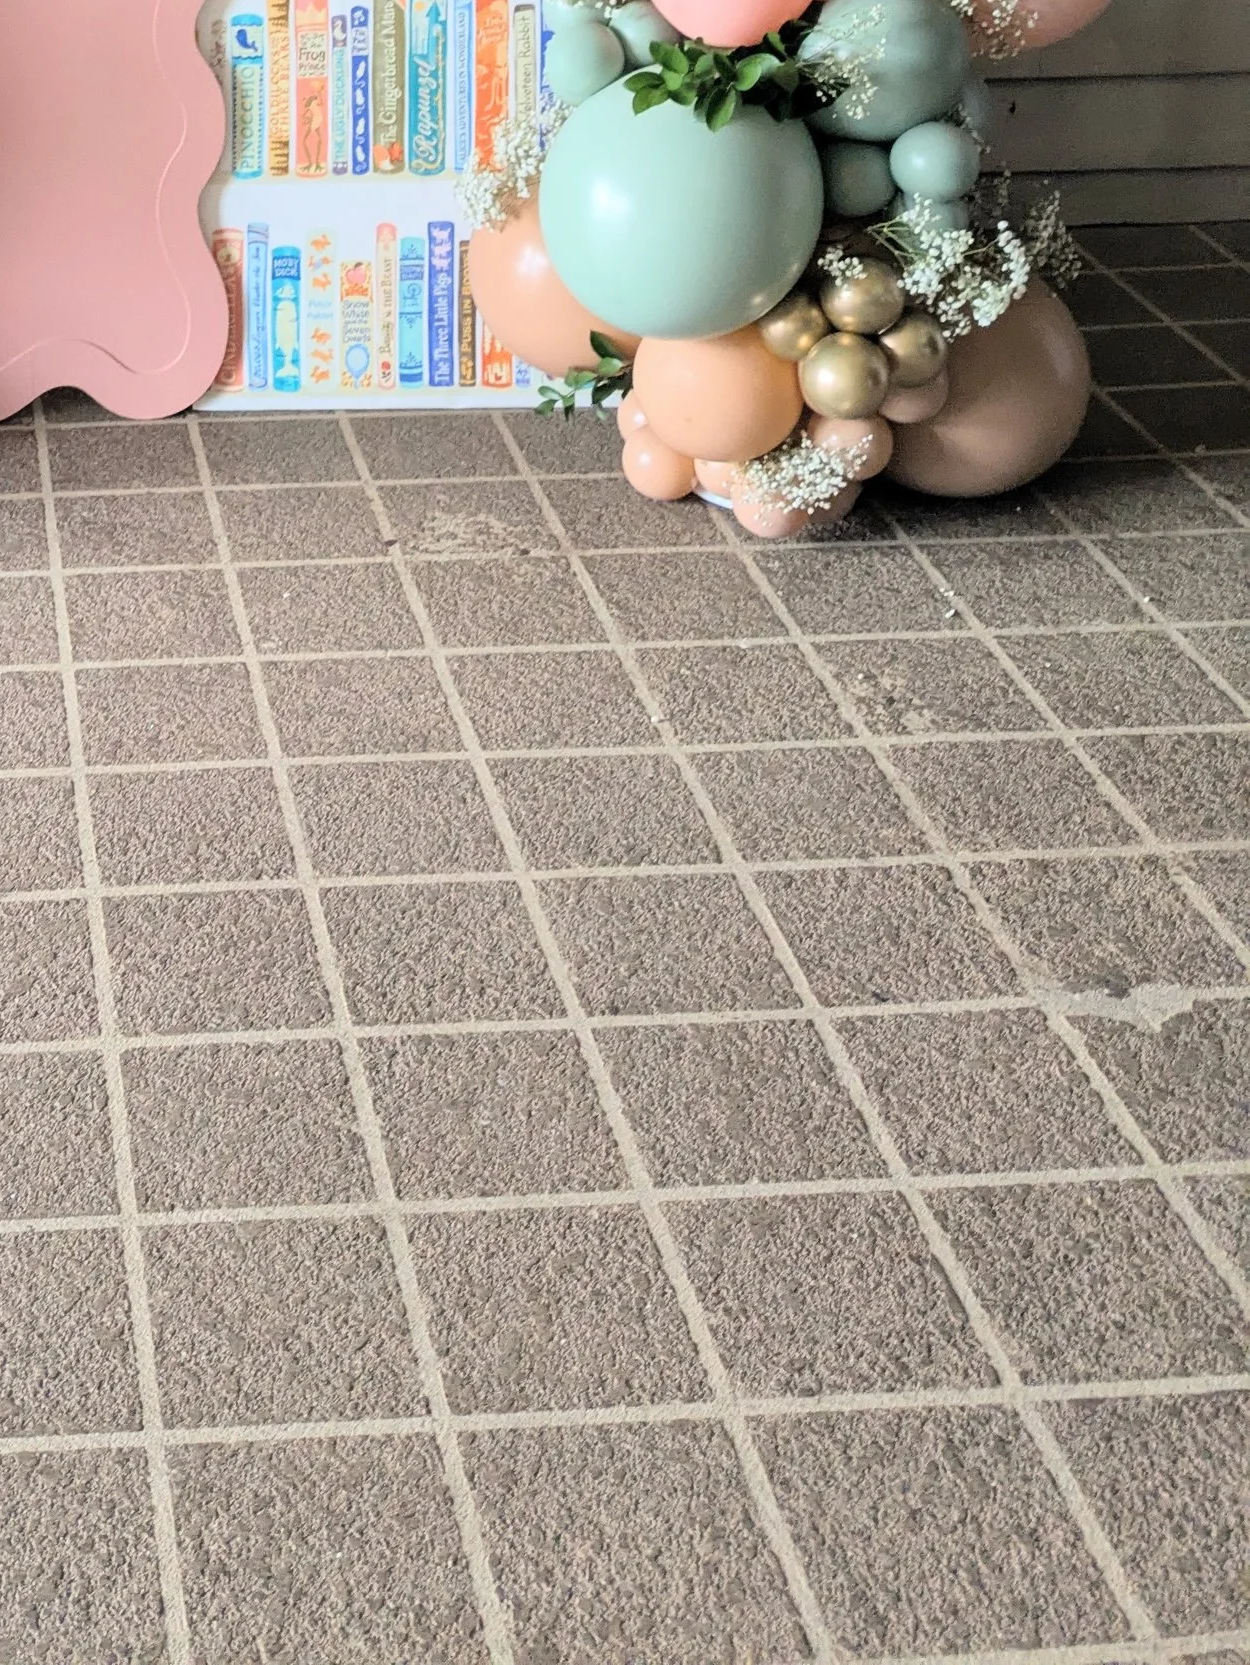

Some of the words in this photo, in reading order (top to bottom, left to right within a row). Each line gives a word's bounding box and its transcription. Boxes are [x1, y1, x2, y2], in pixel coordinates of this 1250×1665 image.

[384, 0, 396, 34] Man
[519, 16, 530, 58] Rabbit
[299, 47, 326, 62] Frog
[379, 37, 402, 124] Gingerbread
[240, 66, 255, 170] PINOCCHIO
[273, 257, 299, 268] MOBY
[274, 267, 299, 277] DICK
[462, 299, 472, 313] IN
[461, 317, 473, 352] PUSS
[434, 363, 449, 383] The
